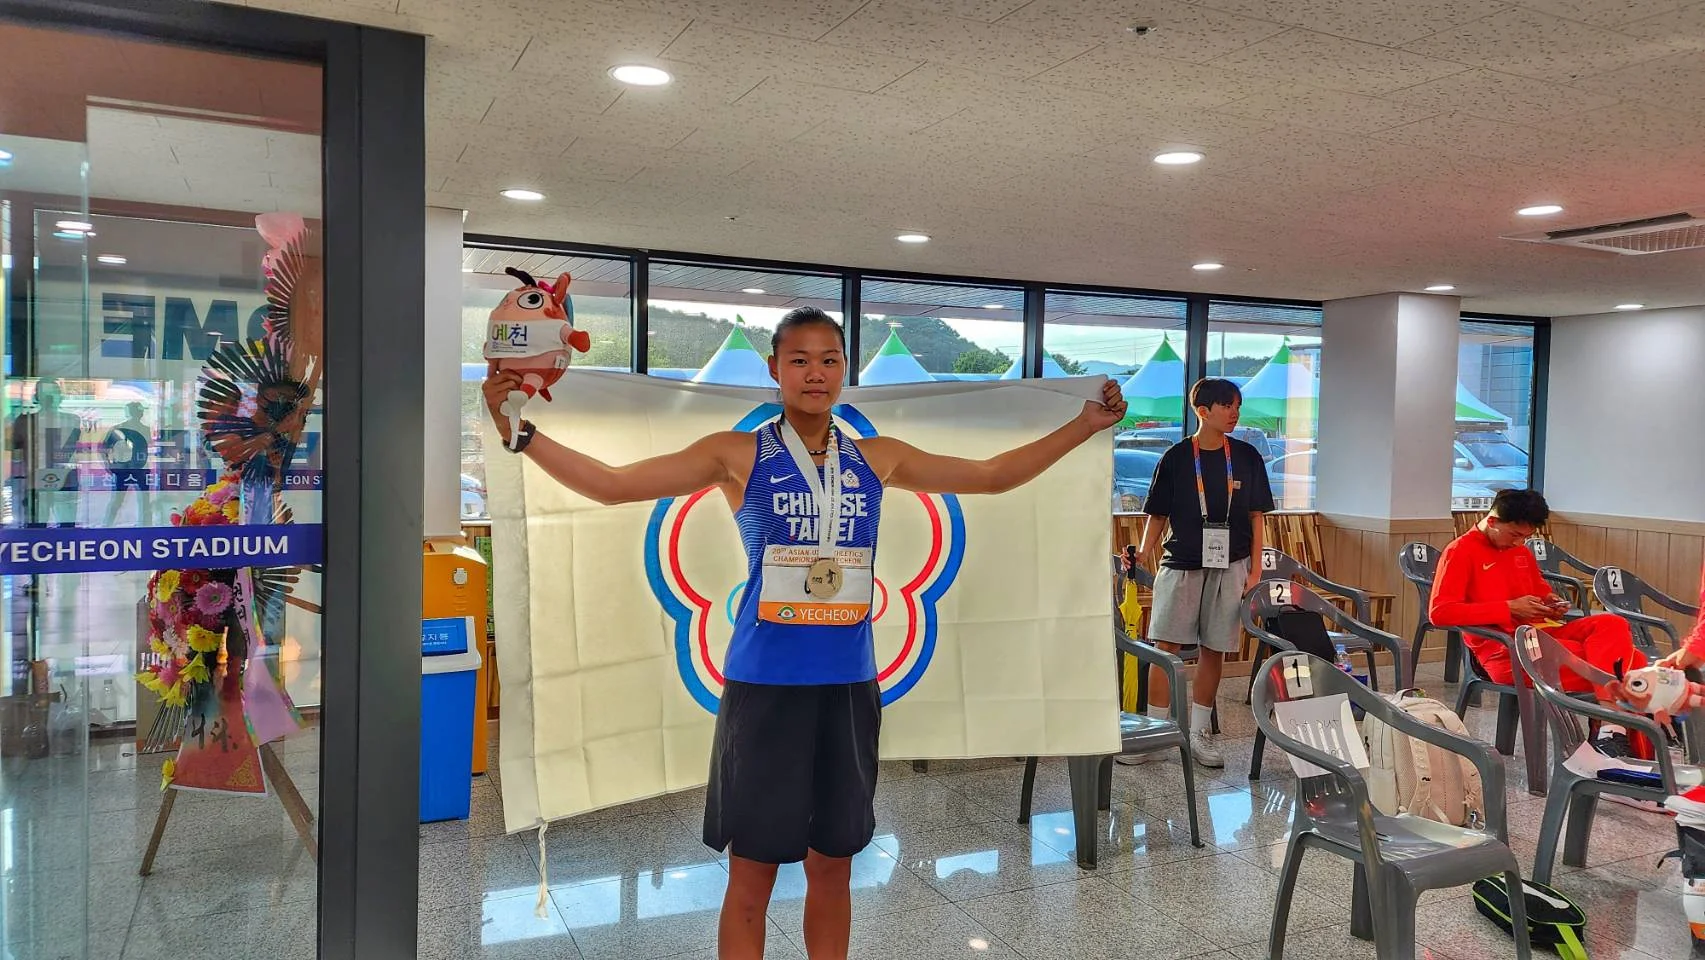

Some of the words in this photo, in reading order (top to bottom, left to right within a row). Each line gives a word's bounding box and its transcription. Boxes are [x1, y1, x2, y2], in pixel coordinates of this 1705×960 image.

[492, 323, 527, 346] 예천
[786, 517, 855, 541] TAIEI
[152, 535, 288, 560] STADIUM
[834, 550, 864, 558] HLETICS
[1417, 545, 1424, 560] 3
[1536, 541, 1543, 556] 3
[835, 557, 862, 565] ECHEON
[1264, 552, 1272, 568] 3
[1610, 570, 1618, 588] 2
[1275, 583, 1285, 604] 2
[800, 608, 859, 621] YECHEON
[1292, 658, 1302, 688] 1
